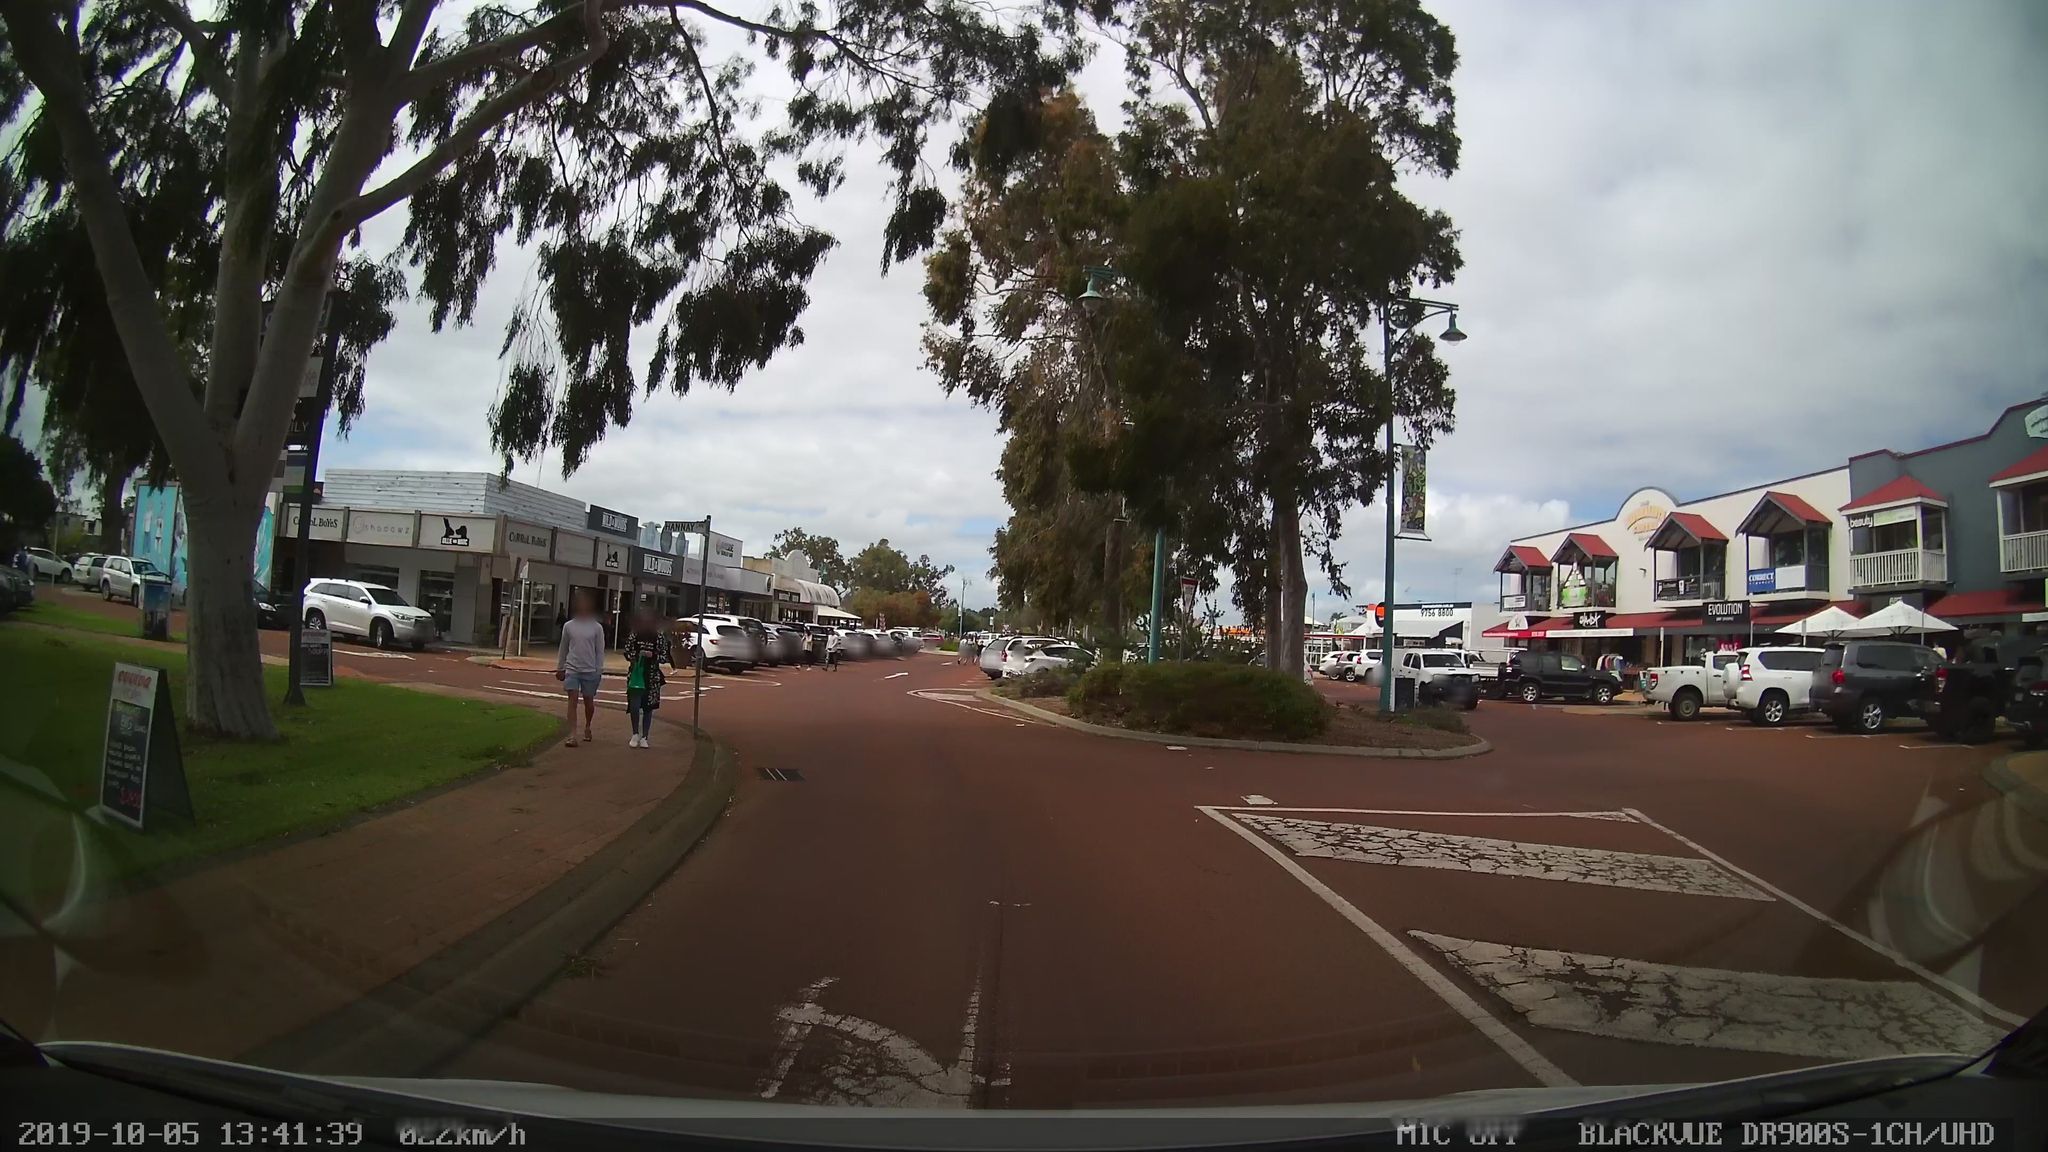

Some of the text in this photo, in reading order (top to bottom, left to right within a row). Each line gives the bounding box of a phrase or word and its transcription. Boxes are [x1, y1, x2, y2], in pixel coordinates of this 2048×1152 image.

[665, 522, 695, 532] HANNAY
[1420, 608, 1454, 617] 9756 8800
[1708, 602, 1743, 616] EVOLUTION
